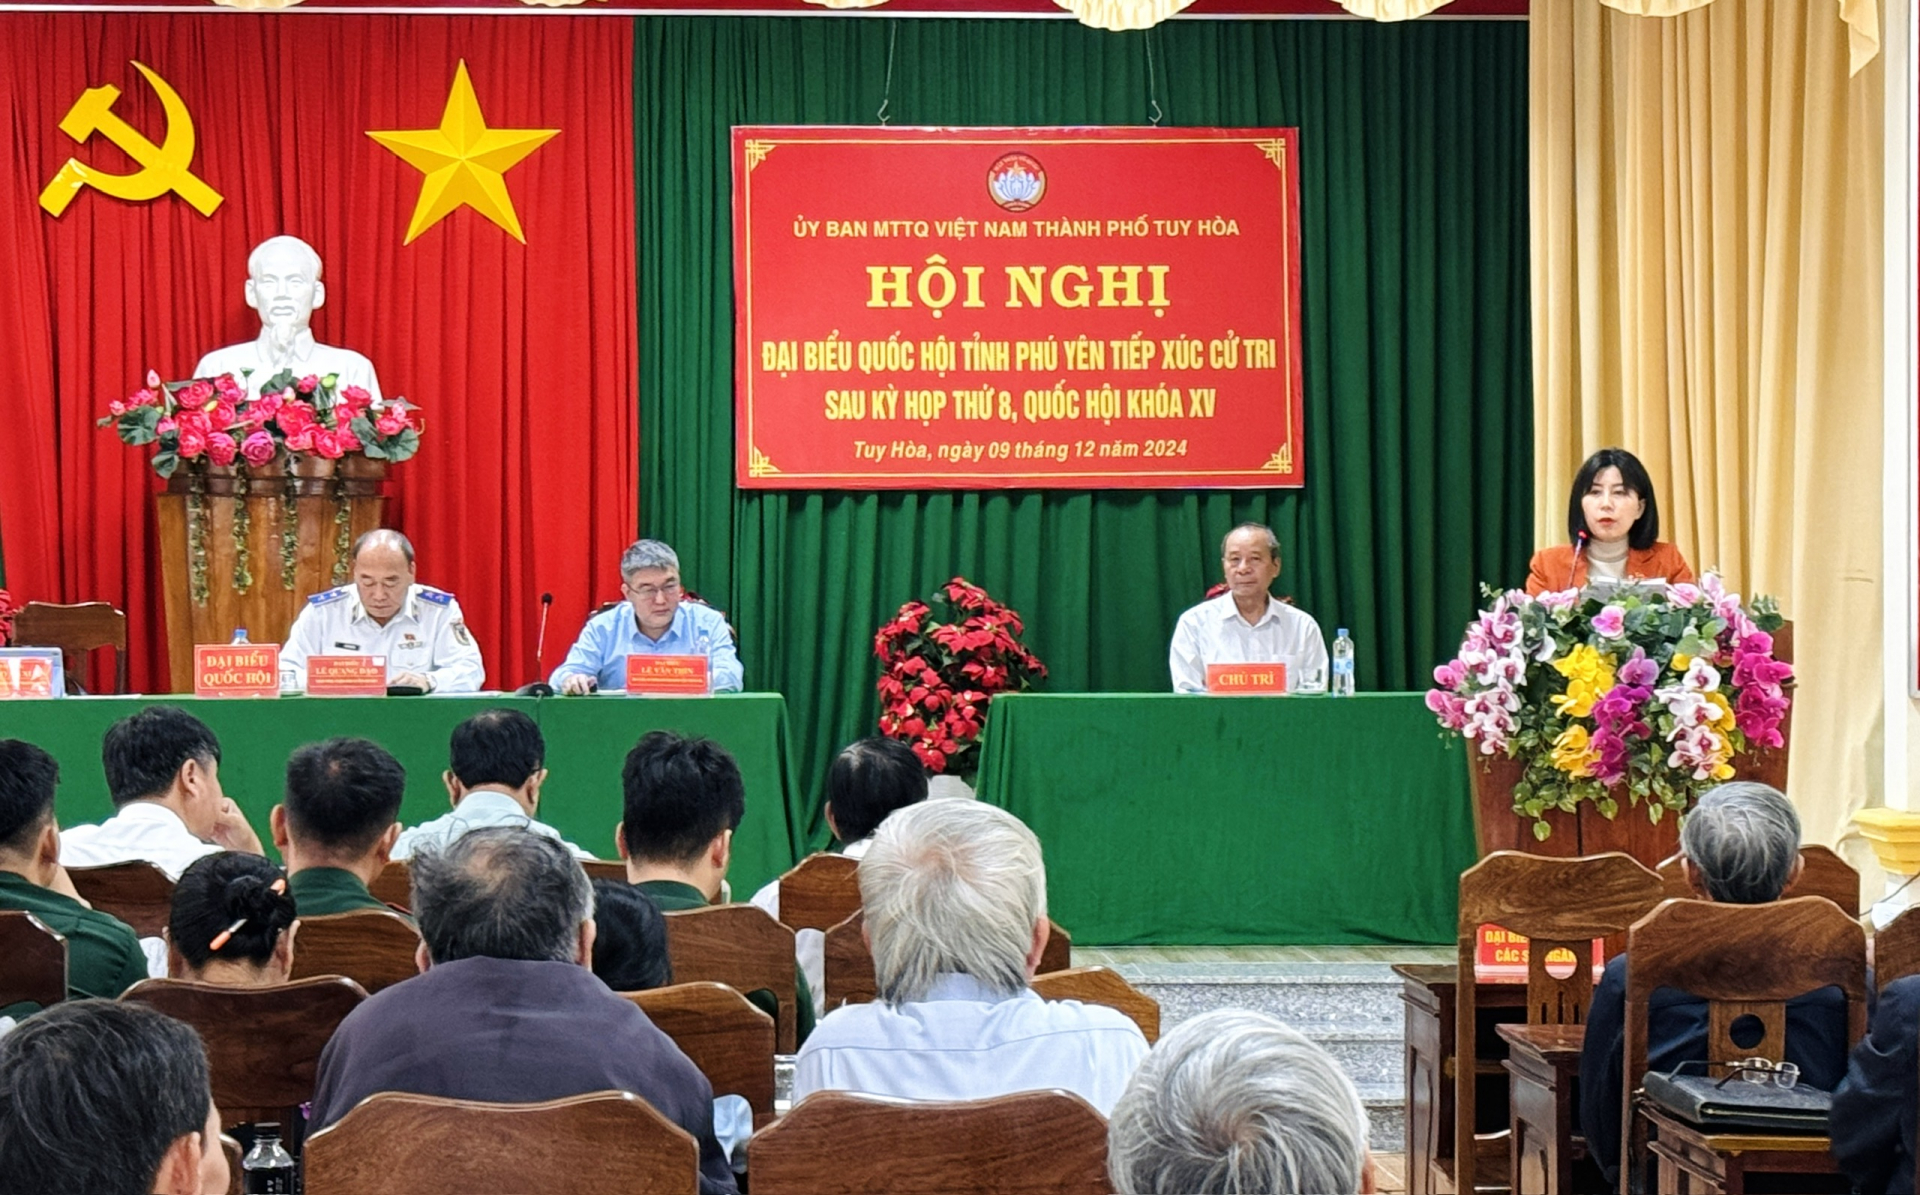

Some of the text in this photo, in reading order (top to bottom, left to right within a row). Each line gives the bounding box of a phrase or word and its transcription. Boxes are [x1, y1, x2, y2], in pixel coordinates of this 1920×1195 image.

[793, 214, 1240, 240] ỦY BAN MTTQ VIỆT NAM THÀNH PHỐ TUY HÒA
[866, 254, 1171, 318] HỘI NGHỊ
[761, 328, 1276, 376] ĐẠI BIỂU QUỐC HỘI TỈNH PHÚ YÊN TIẾP XÚC CỬ TRI
[824, 378, 1216, 427] SAU KỲ HỌP THỨ 8, QUỐC HỘI KHÓA XV
[853, 439, 1188, 463] Tuy Hòa, ngày 09 tháng 12 năm 2024
[206, 655, 232, 669] ĐẠI
[203, 668, 271, 686] QUỐC HỘI
